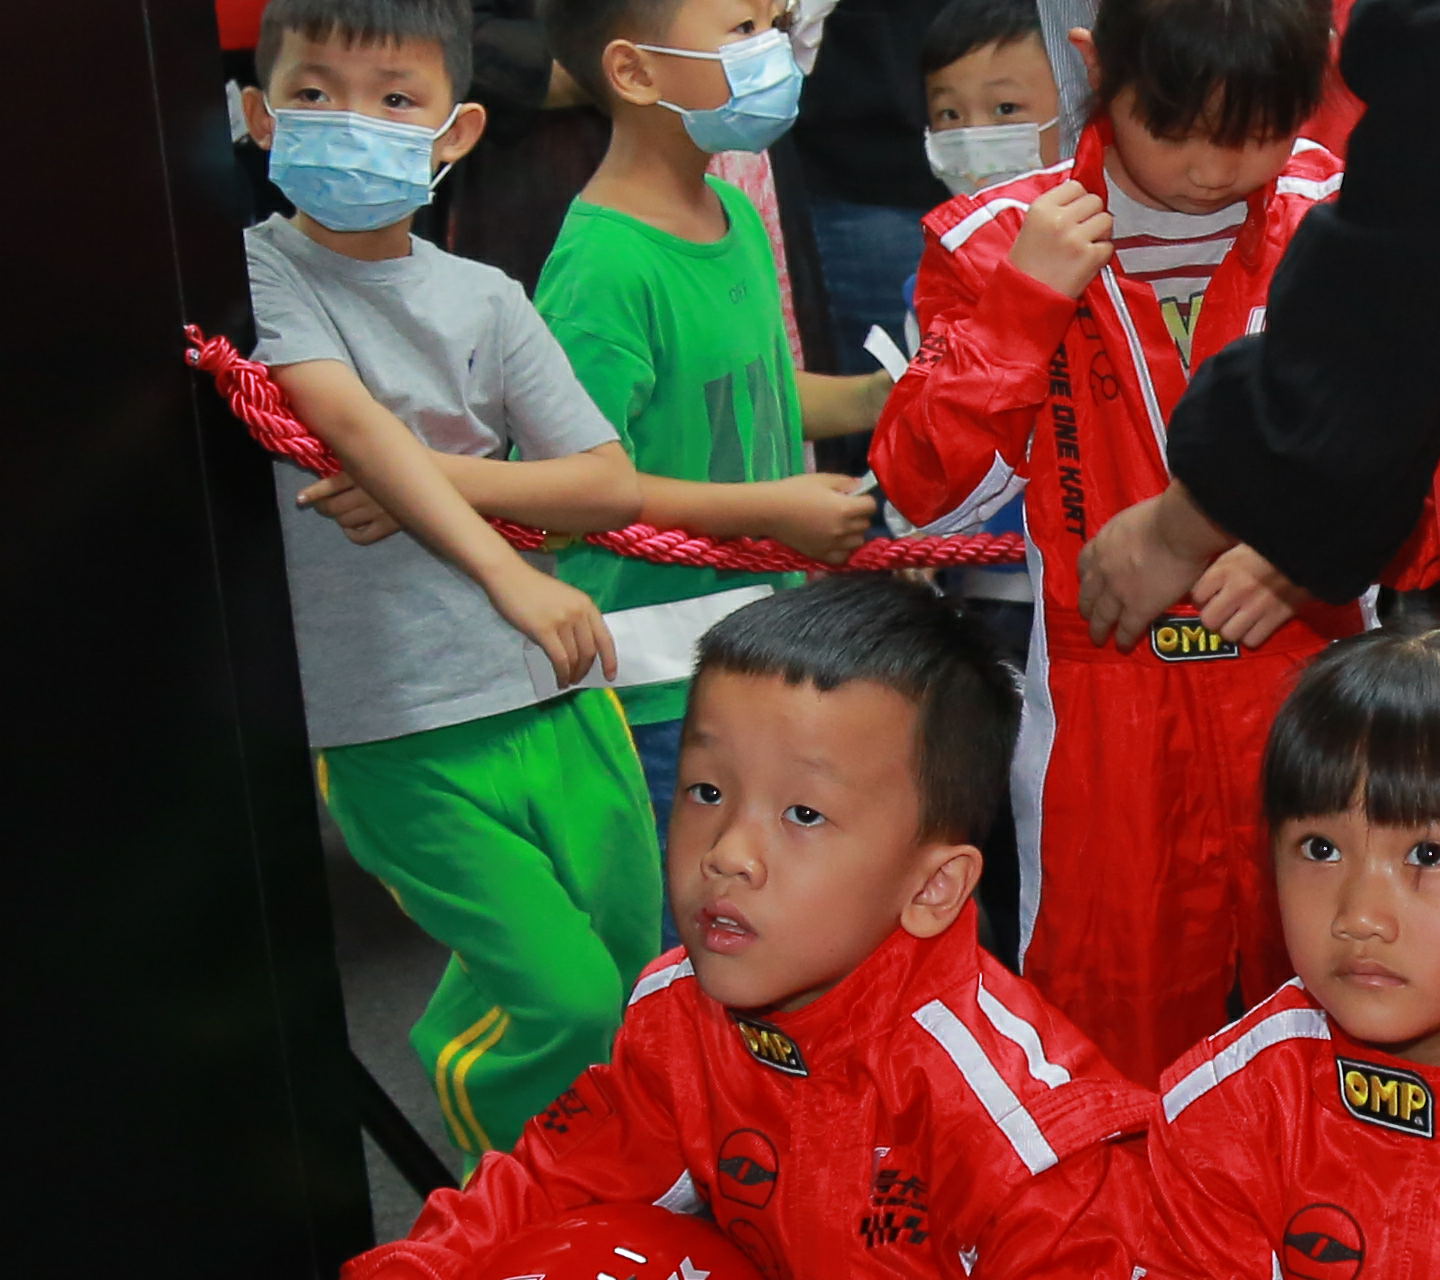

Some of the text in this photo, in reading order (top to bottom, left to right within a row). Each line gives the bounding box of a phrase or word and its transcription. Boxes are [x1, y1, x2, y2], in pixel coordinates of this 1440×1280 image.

[1052, 403, 1080, 461] ONE
[1060, 466, 1087, 543] KART
[1344, 1073, 1427, 1122] OMP
